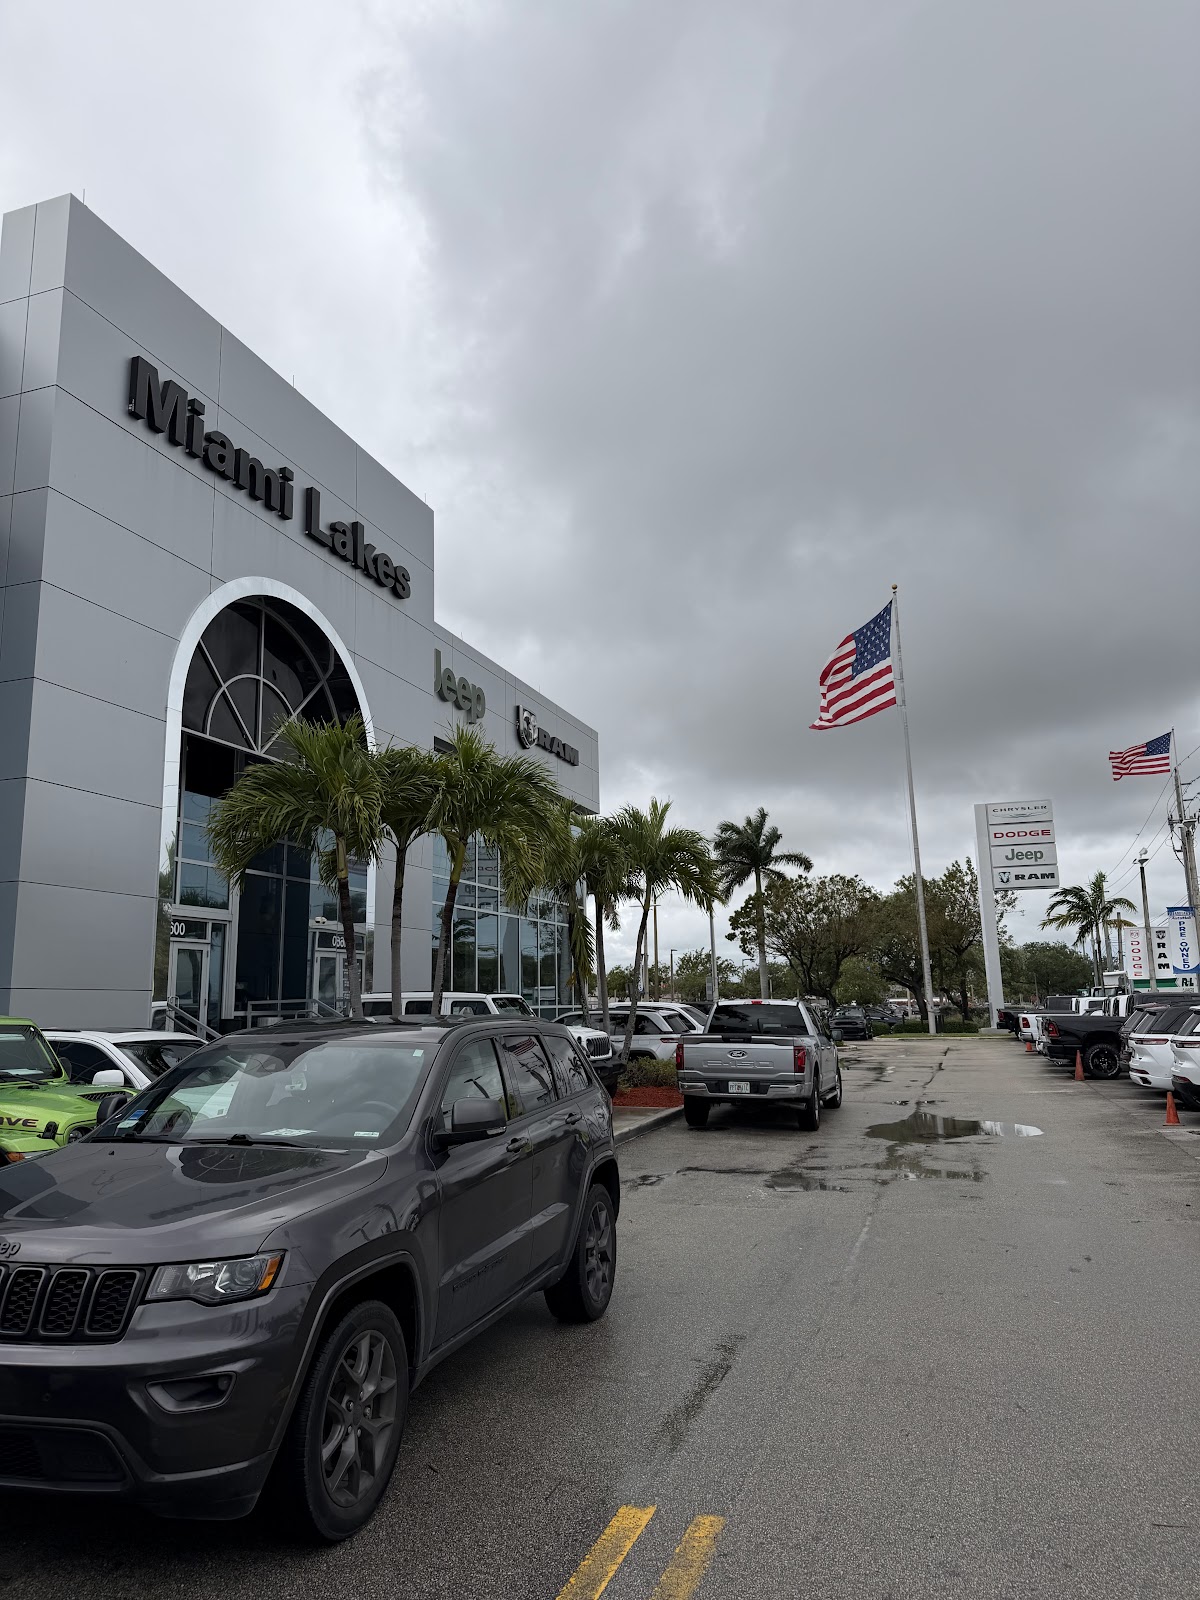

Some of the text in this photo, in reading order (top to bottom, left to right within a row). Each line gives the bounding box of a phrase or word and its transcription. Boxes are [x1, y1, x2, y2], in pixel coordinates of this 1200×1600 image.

[128, 355, 411, 600] Miami Lakes
[434, 648, 486, 724] Jeep
[537, 728, 579, 767] RAM
[992, 805, 1047, 813] CHRYSLER
[993, 829, 1051, 839] DODGE
[1005, 848, 1044, 862] Jeep
[1014, 872, 1055, 881] RAM
[1130, 940, 1143, 977] DODGE
[1156, 942, 1170, 970] RAM
[1178, 921, 1191, 969] PRE-OWNED
[0, 1241, 21, 1258] ep
